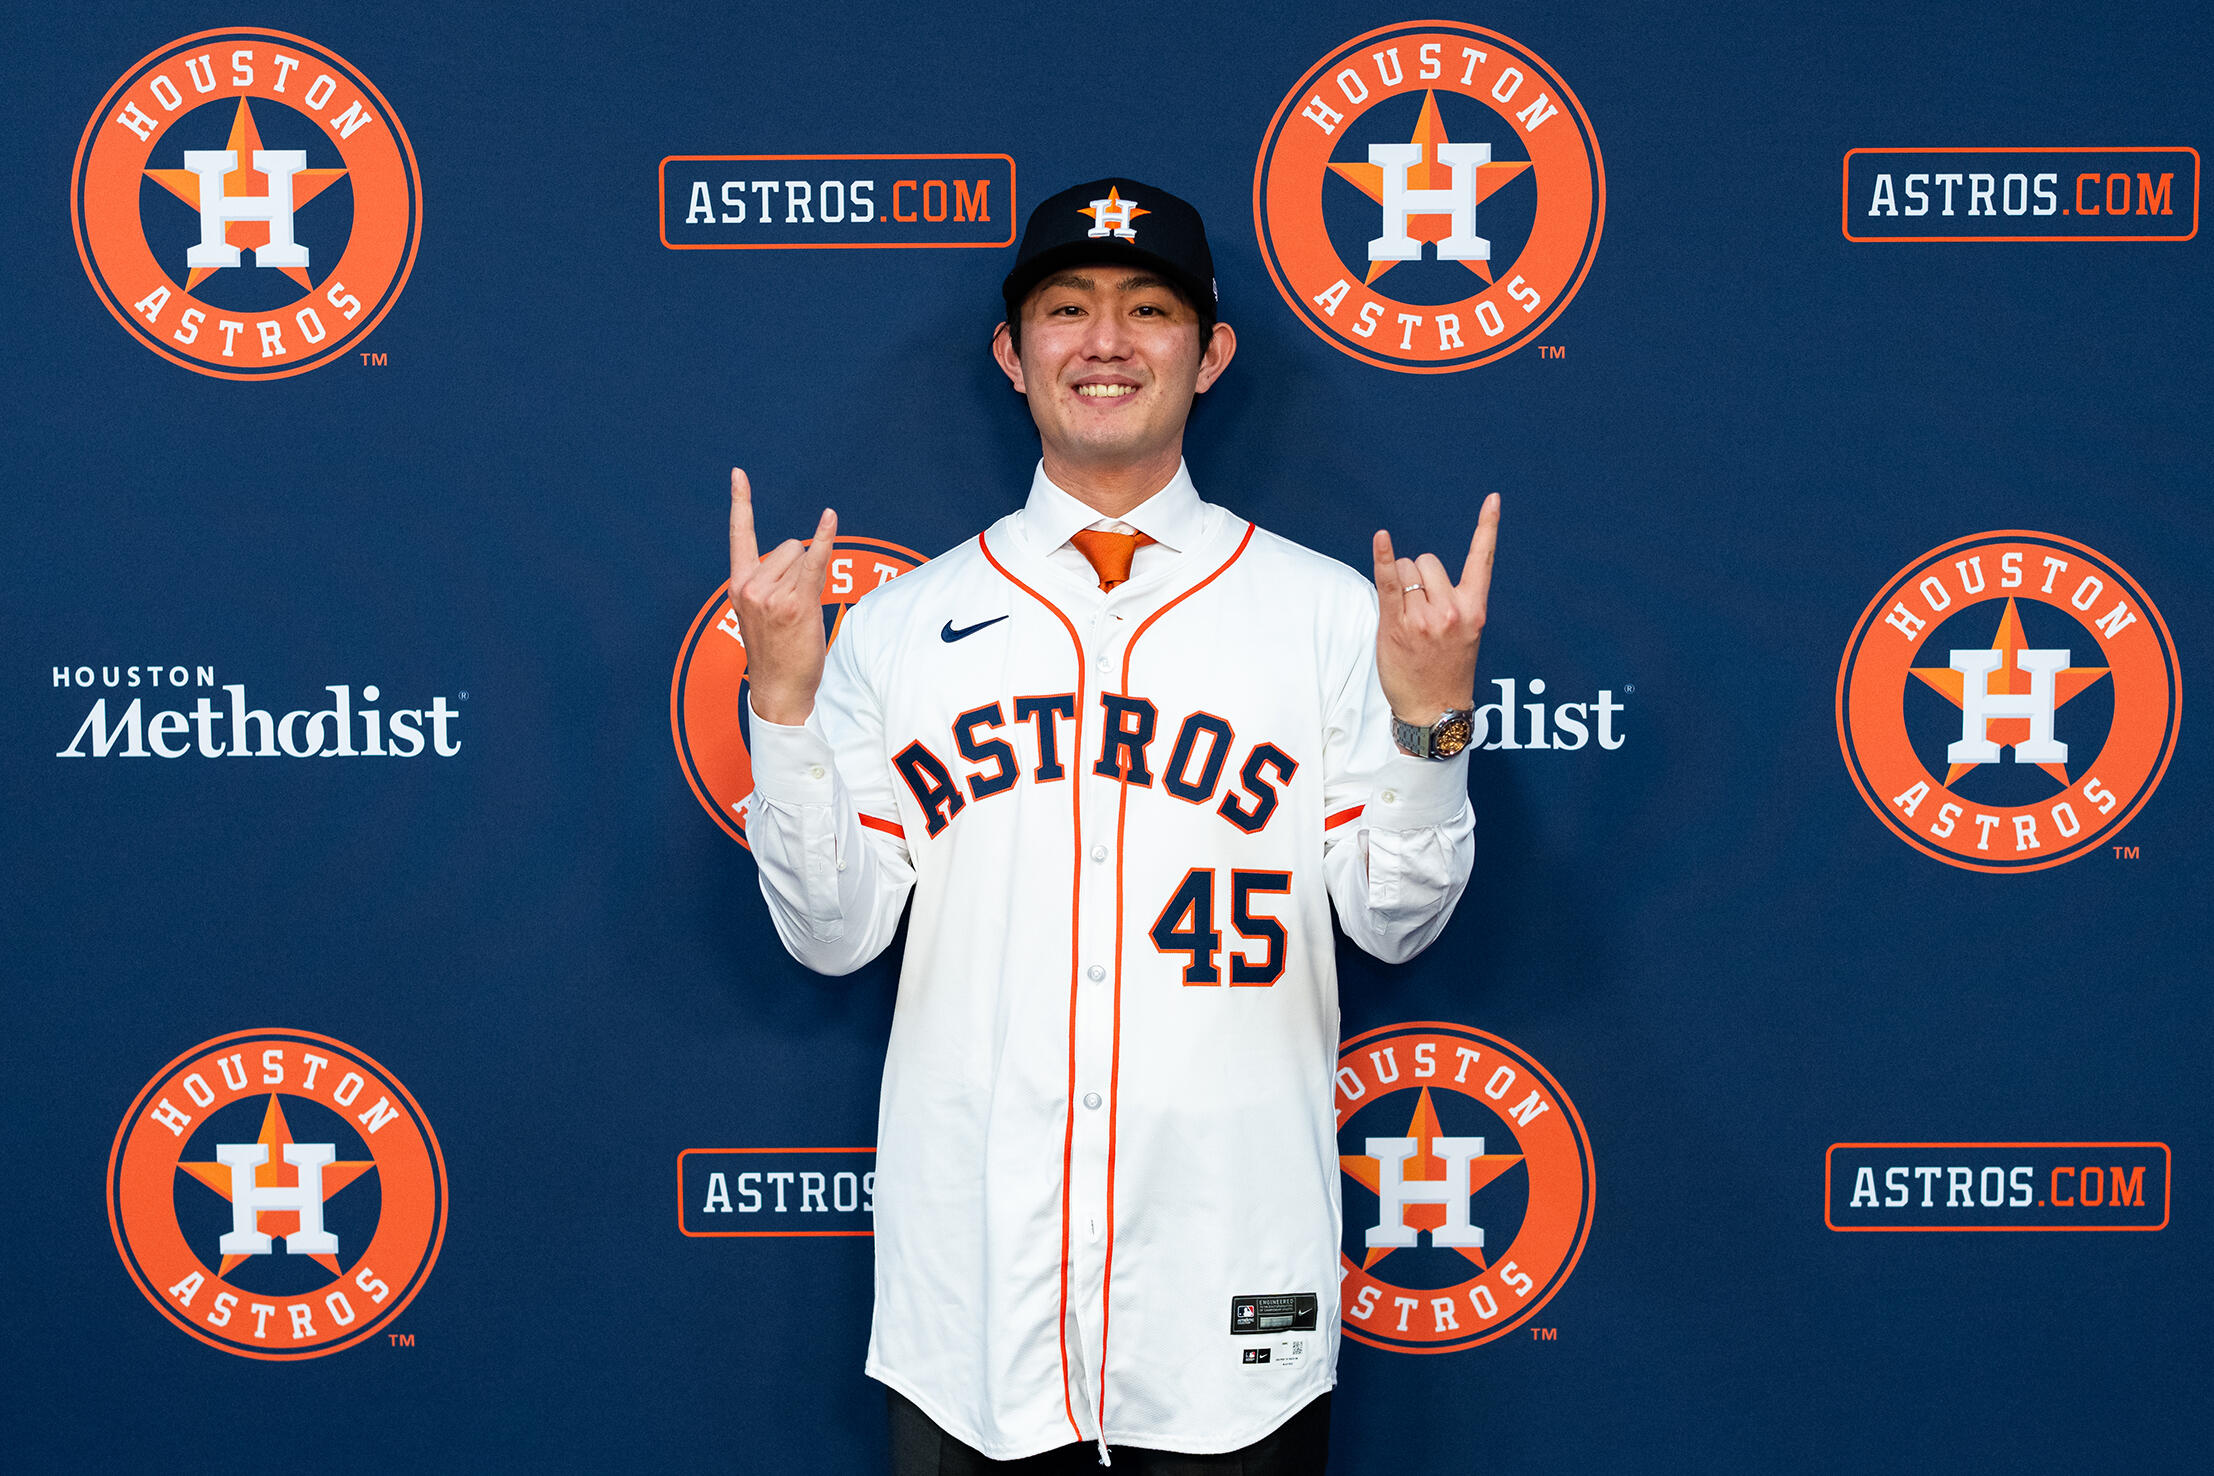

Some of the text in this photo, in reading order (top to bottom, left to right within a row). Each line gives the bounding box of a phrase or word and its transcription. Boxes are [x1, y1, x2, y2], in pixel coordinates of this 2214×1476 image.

[116, 50, 372, 142] HOUSTON
[1302, 44, 1558, 135] HOUSTON
[184, 150, 309, 268] H
[686, 180, 990, 223] ASTROS.COM
[1087, 198, 1138, 238] H
[1368, 143, 1491, 261] H
[1868, 173, 2174, 216] ASTROS.COM
[134, 282, 361, 358] ASTROS
[1313, 275, 1541, 351] ASTROS
[360, 353, 388, 366] TM
[1538, 346, 1565, 359] TM
[1885, 552, 2137, 641] HOUSTON
[53, 666, 214, 687] HOUSTON
[1948, 649, 2070, 763] H
[891, 691, 1299, 840] ASTROS
[1893, 777, 2116, 851] ASTROS
[2113, 847, 2140, 859] TM
[1148, 867, 1293, 987] 45
[151, 1050, 399, 1136] HOUSTON
[1335, 1044, 1549, 1127] OUSTON
[216, 1143, 338, 1254] H
[1366, 1137, 1484, 1247] H
[1850, 1167, 2146, 1207] ASTROS.COM
[169, 1268, 389, 1339] ASTROS
[1340, 1261, 1533, 1333] STROS
[1531, 1328, 1557, 1340] TM
[389, 1335, 415, 1347] TM
